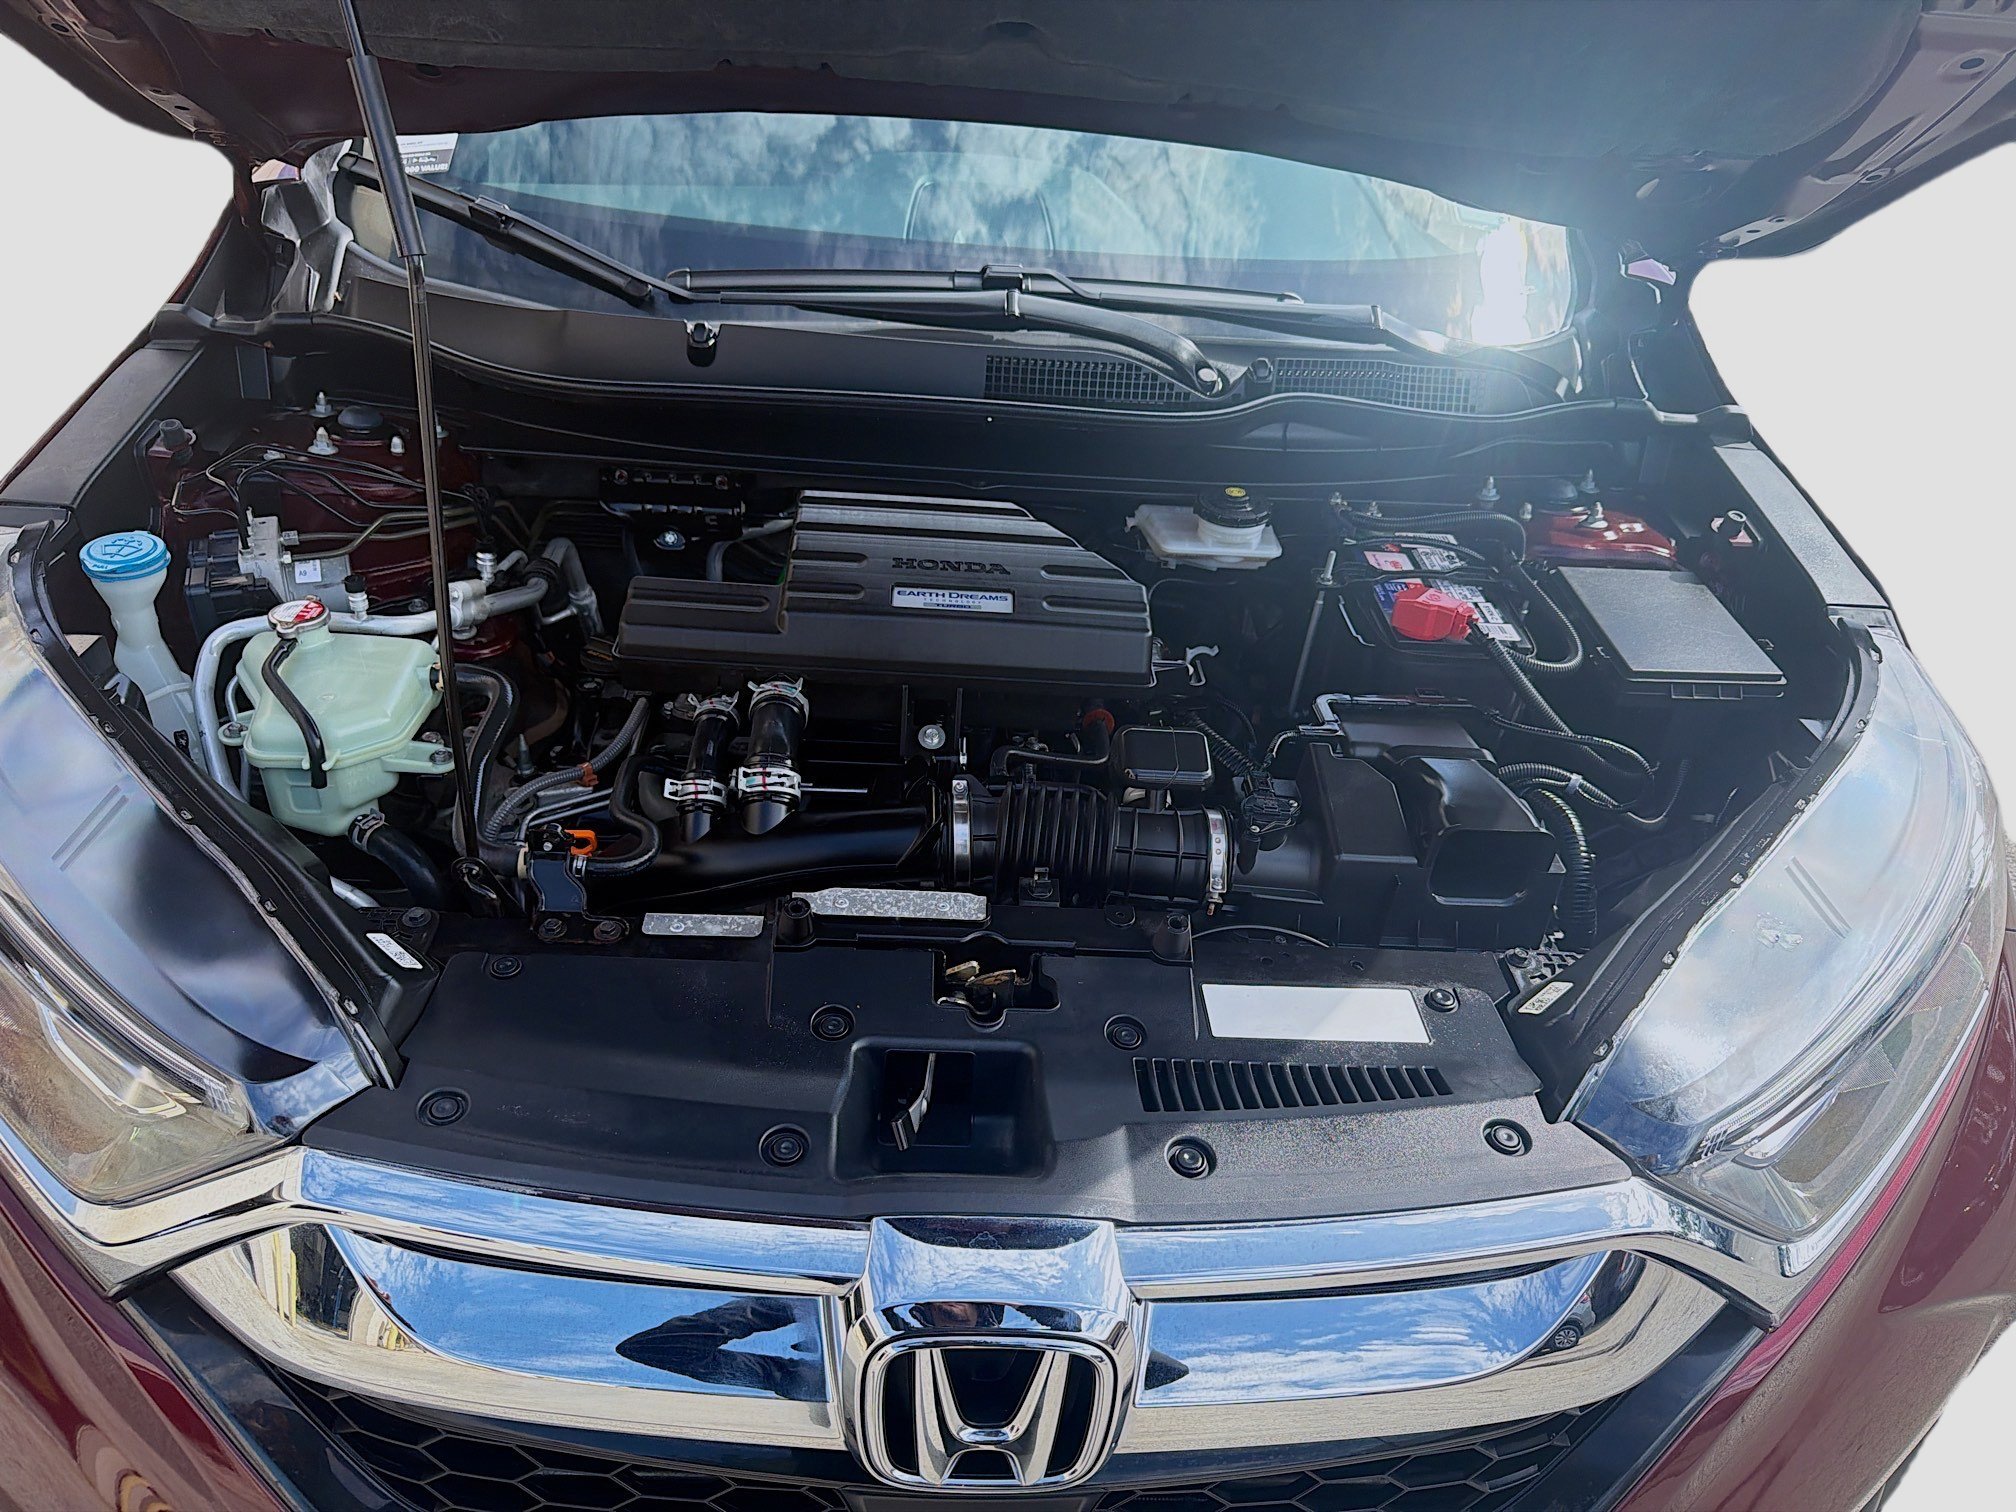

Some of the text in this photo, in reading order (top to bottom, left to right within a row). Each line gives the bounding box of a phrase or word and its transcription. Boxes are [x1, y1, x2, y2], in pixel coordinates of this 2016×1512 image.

[892, 557, 1011, 575] HONDA
[896, 590, 1008, 602] EARTH DREAMS
